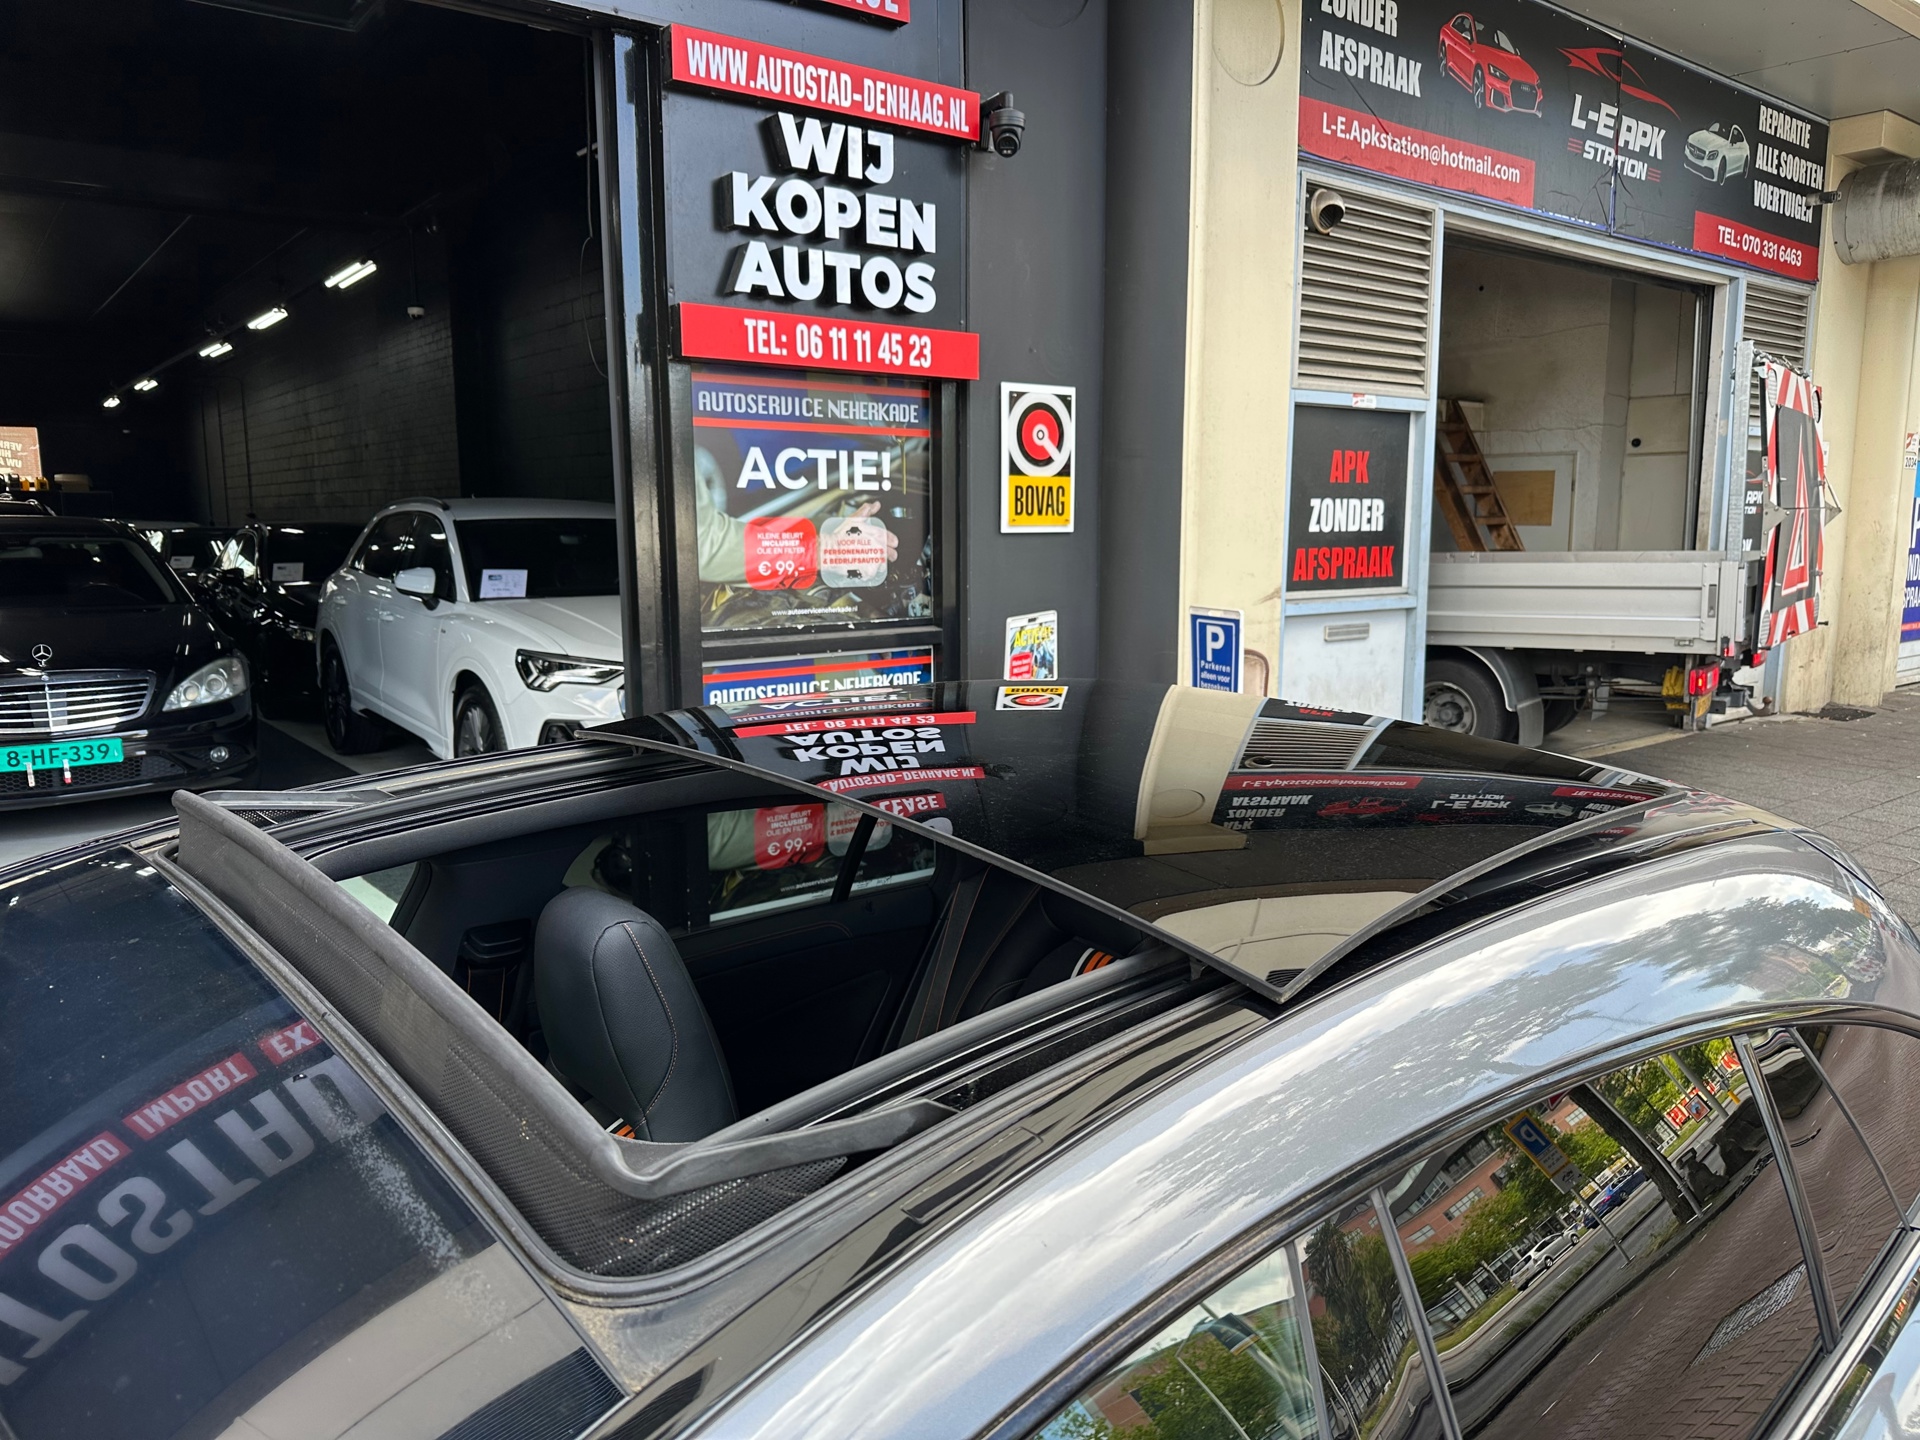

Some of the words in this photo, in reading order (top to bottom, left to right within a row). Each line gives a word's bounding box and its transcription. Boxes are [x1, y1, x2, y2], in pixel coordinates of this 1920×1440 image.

[1320, 31, 1422, 97] AFSPRAAK
[687, 38, 969, 132] WWW.AUTOSTAD-DENHAAG.NL
[1759, 104, 1811, 149] REPARATIE
[778, 112, 894, 184] WIJ
[1322, 112, 1520, 184] L-E.Apkstation@hotmail.com
[1755, 143, 1778, 175] ALLE
[1779, 151, 1824, 190] SOORTEN
[732, 172, 936, 253] KOPEN
[1718, 225, 1740, 249] TEL:
[1742, 233, 1760, 255] 070
[1762, 240, 1778, 260] 331
[1779, 245, 1802, 267] 6463
[734, 241, 936, 313] AUTOS
[744, 318, 787, 356] TEL:
[796, 322, 822, 359] 06
[829, 328, 848, 361] 11
[854, 330, 871, 363] 11
[877, 333, 903, 366] 45
[909, 335, 931, 368] 23
[698, 391, 823, 418] AUTOSERVICE
[828, 400, 919, 423] NEHERKADE
[736, 447, 891, 491] ACTIE!
[1330, 450, 1370, 483] APK
[1014, 485, 1065, 517] BOVAG
[1308, 498, 1384, 533] ZONDER
[758, 561, 771, 576] €
[775, 560, 805, 577] 99,-
[1293, 546, 1395, 582] AFSPRAAK
[1206, 625, 1225, 662] P
[1200, 660, 1230, 673] Parkeren
[7, 743, 109, 767] 8-HF-339
[771, 817, 807, 829] INCLUSIEF
[768, 842, 779, 856] €
[784, 838, 812, 854] 99,-
